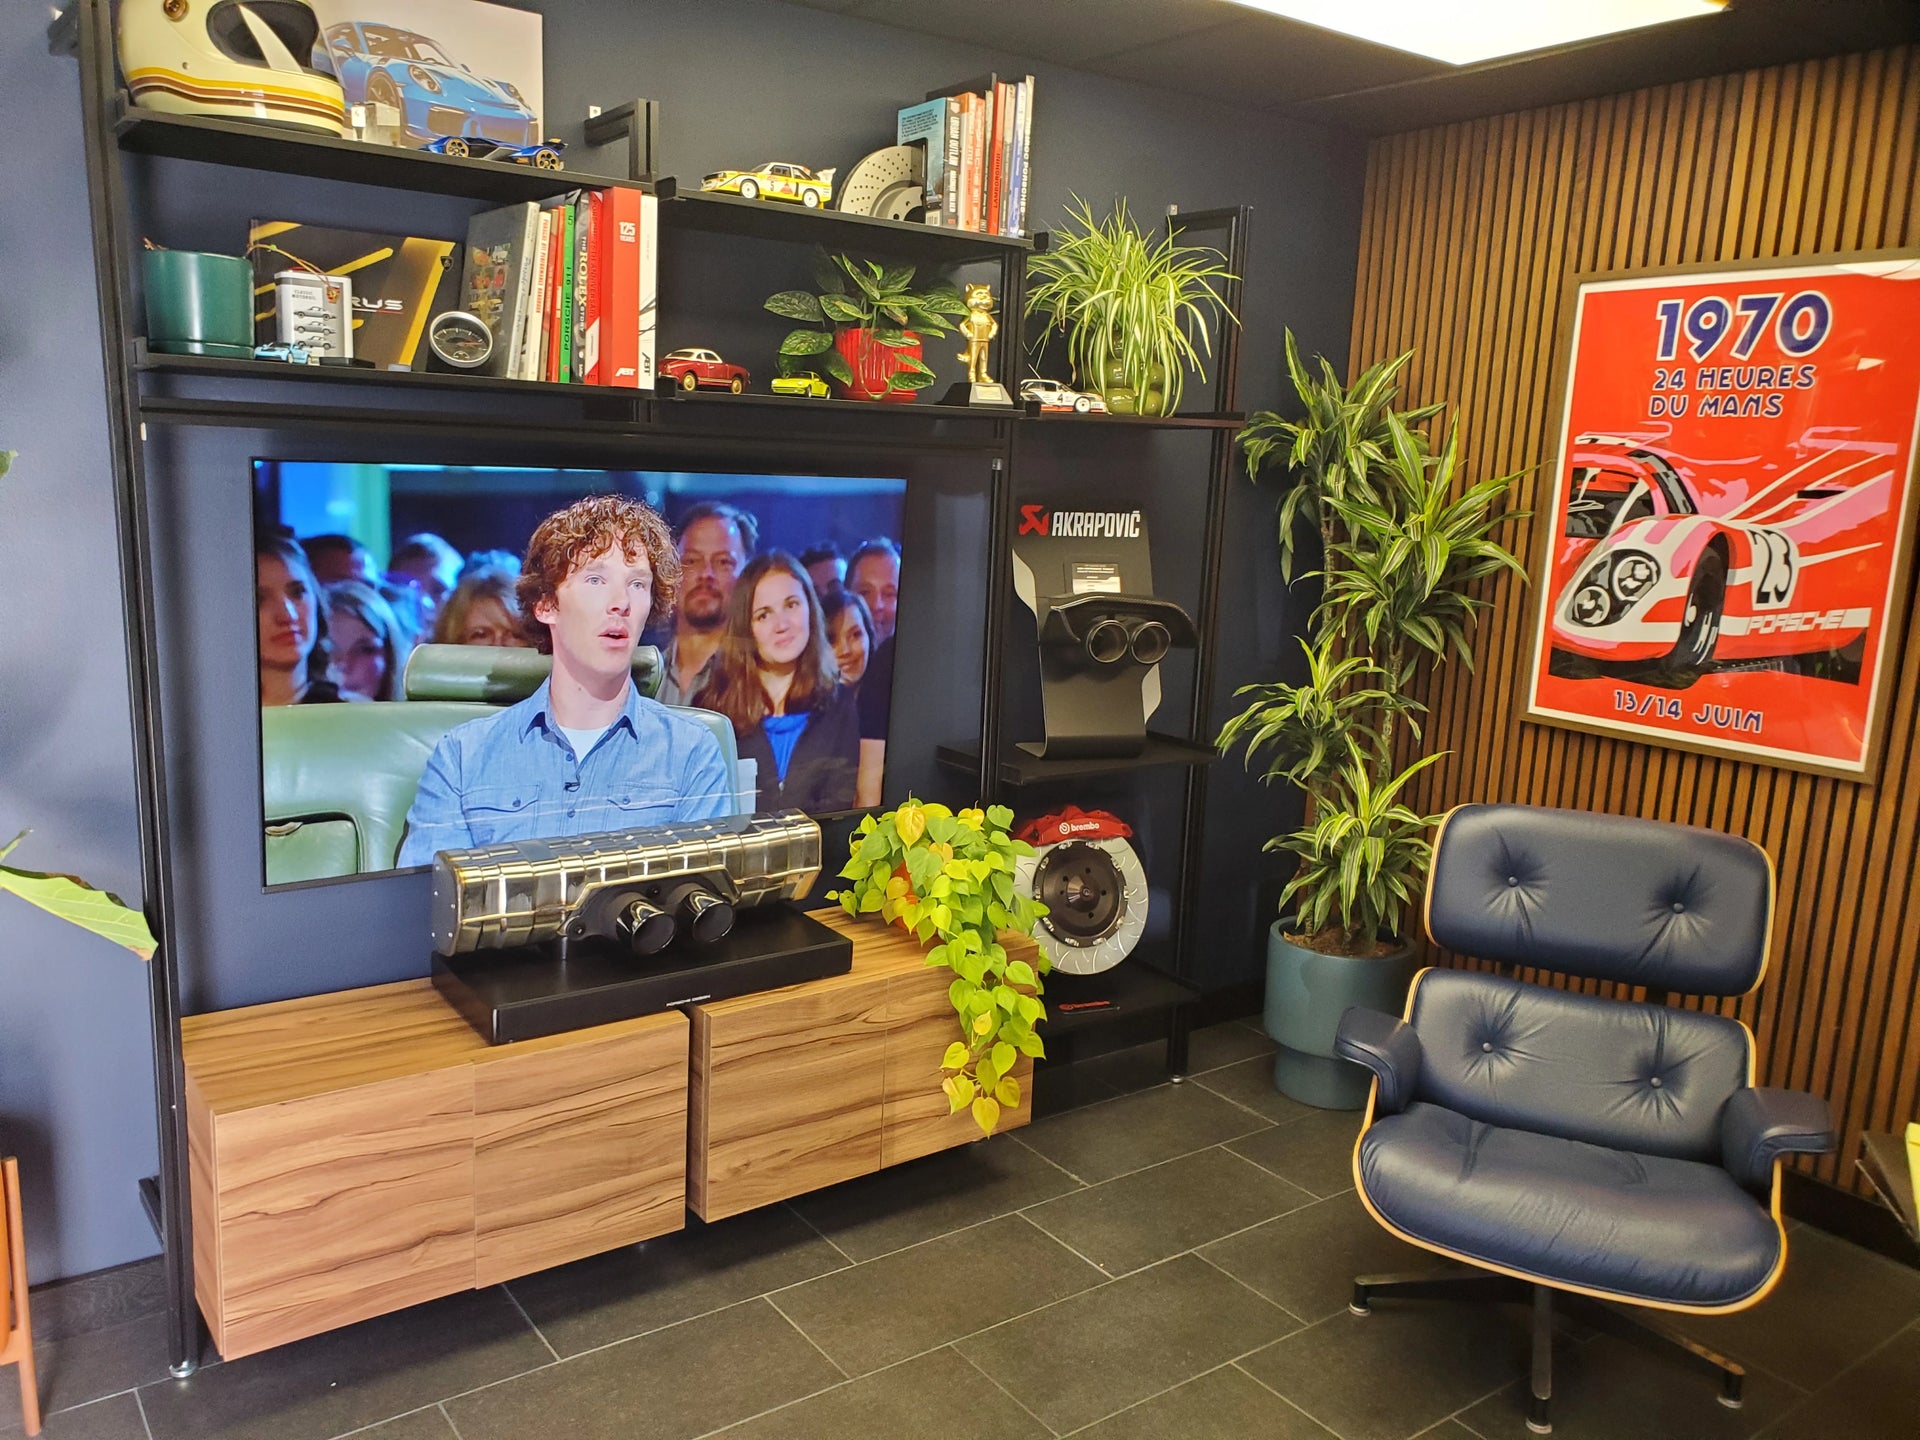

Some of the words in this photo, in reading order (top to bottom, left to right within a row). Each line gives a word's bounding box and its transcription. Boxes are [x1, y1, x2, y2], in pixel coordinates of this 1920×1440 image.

[948, 139, 960, 167] OUTLAW
[769, 180, 775, 192] 5
[993, 153, 1001, 209] LAMBORGHINI
[619, 221, 636, 236] 125
[578, 251, 588, 307] ROLEX
[351, 296, 403, 310] RUS
[563, 293, 572, 351] PORSCHE
[1656, 290, 1833, 364] 1970
[1652, 367, 1685, 391] 24
[1695, 364, 1818, 391] HEURES
[1057, 393, 1064, 403] 4
[1648, 394, 1689, 418] DU
[1697, 392, 1785, 418] MANS
[1051, 510, 1141, 538] AKRAPOVIČ
[1747, 528, 1793, 605] 23
[1745, 608, 1847, 635] PORSCHE
[1614, 689, 1682, 720] 13/14
[1693, 703, 1763, 733] JUIN
[1070, 821, 1100, 832] brembo
